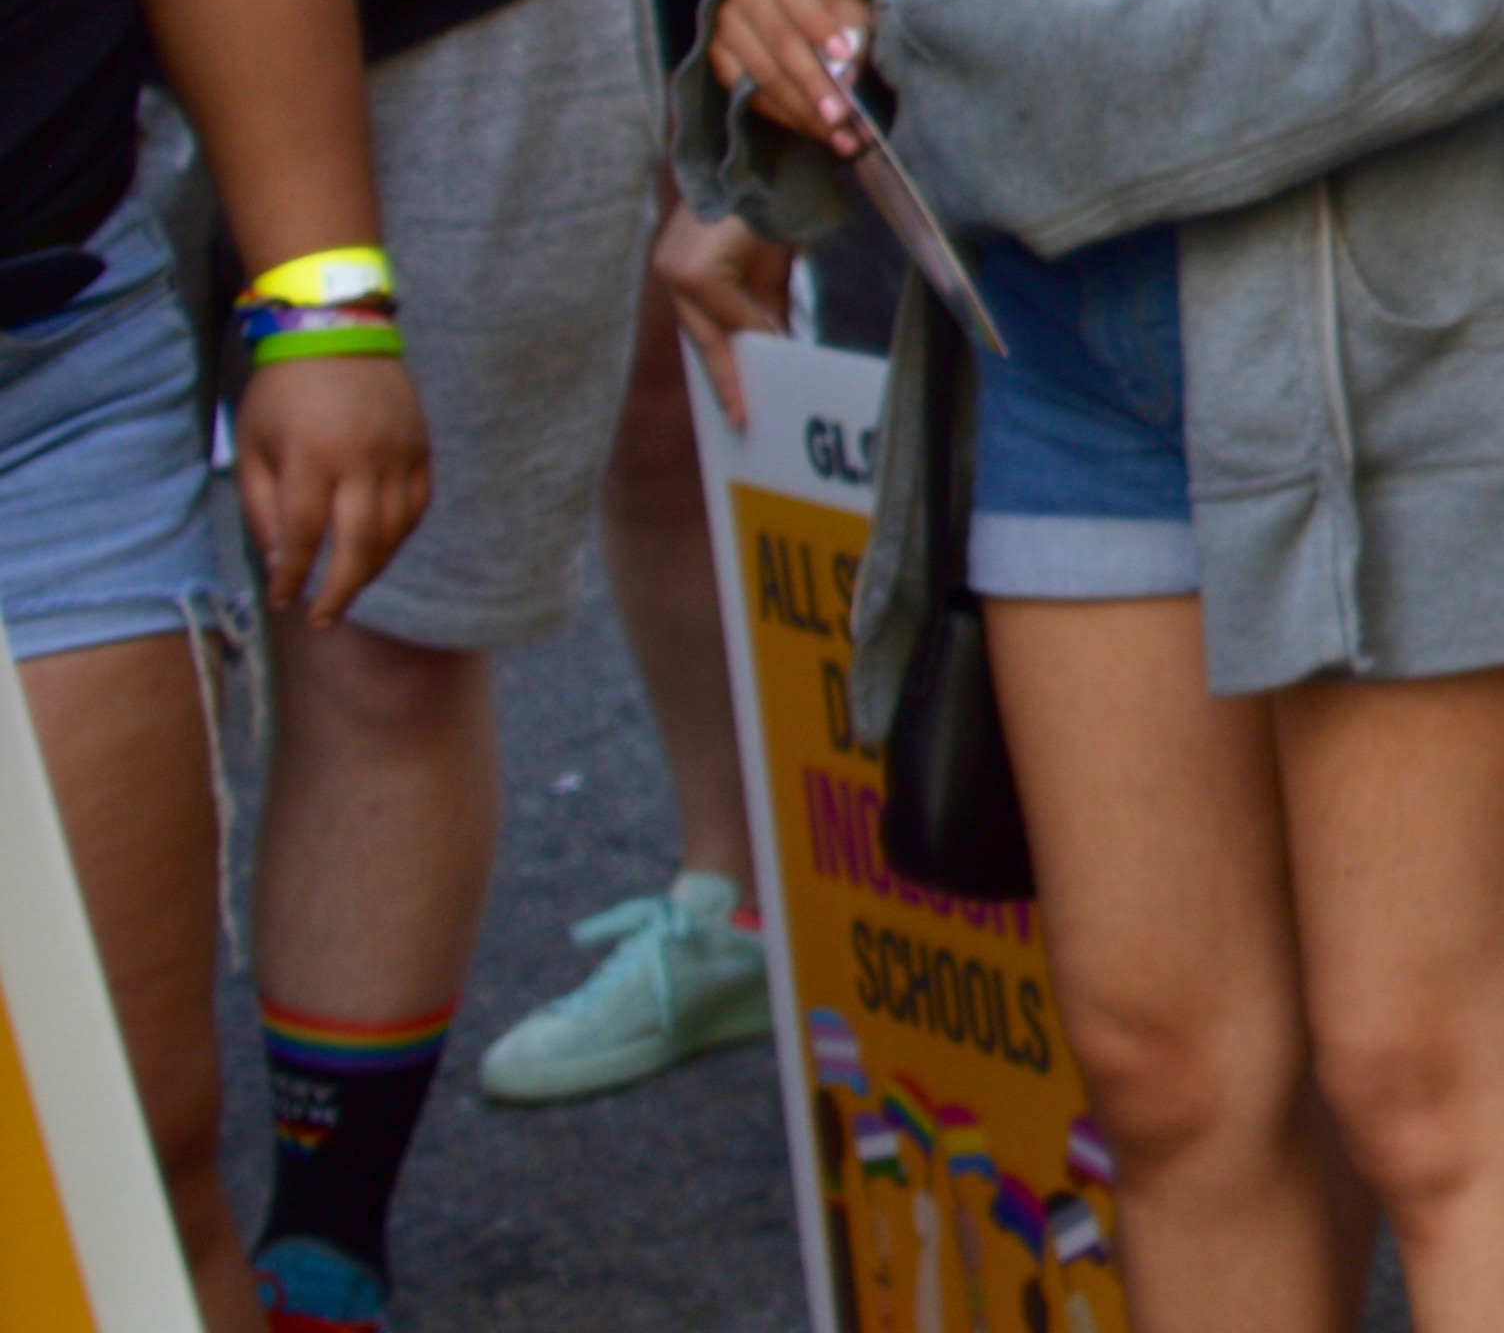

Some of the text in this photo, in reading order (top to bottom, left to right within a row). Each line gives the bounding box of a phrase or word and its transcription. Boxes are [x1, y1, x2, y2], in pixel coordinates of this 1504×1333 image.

[805, 417, 877, 486] GLS
[755, 531, 833, 635] ALL
[852, 921, 1052, 1077] SCHOOLS
